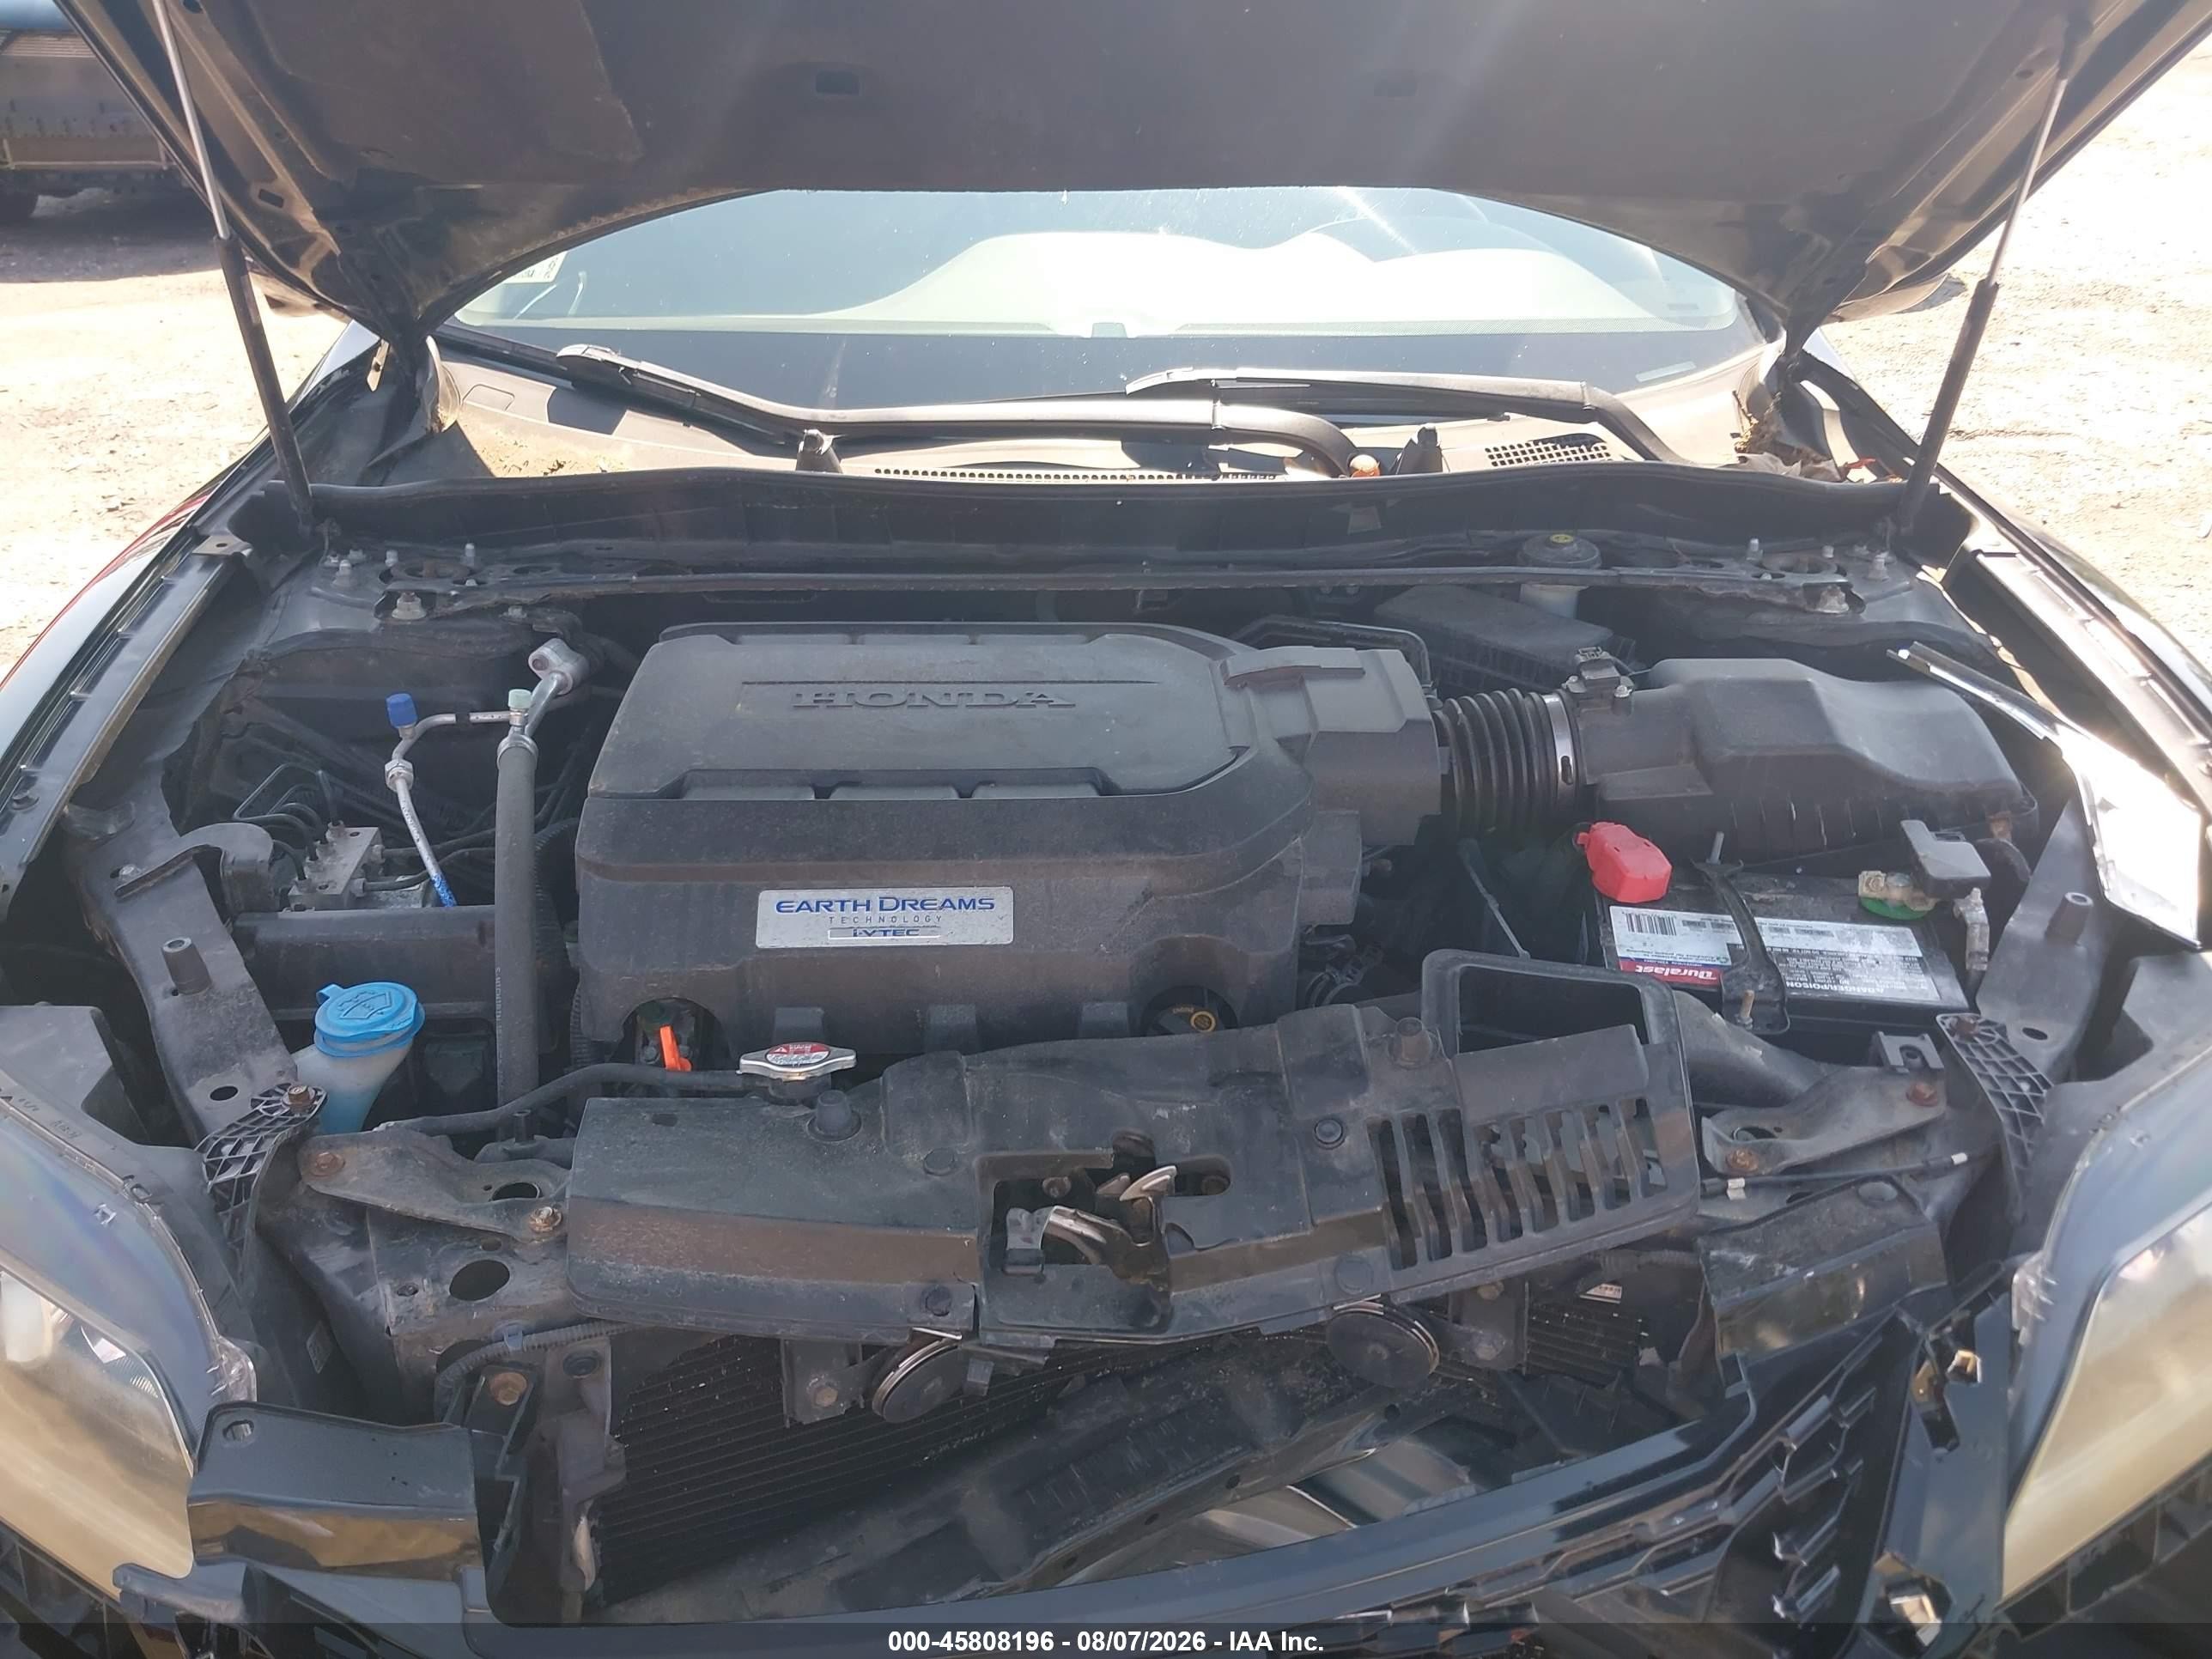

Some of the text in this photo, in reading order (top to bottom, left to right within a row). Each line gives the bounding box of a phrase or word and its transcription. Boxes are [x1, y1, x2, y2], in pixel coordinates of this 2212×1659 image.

[793, 691, 1076, 708] HONDA
[775, 896, 995, 914] EARTH DREAMS
[829, 915, 942, 924] TECHNOLOGY
[853, 928, 920, 938] i-VTEC
[1635, 964, 1717, 981] Duralast
